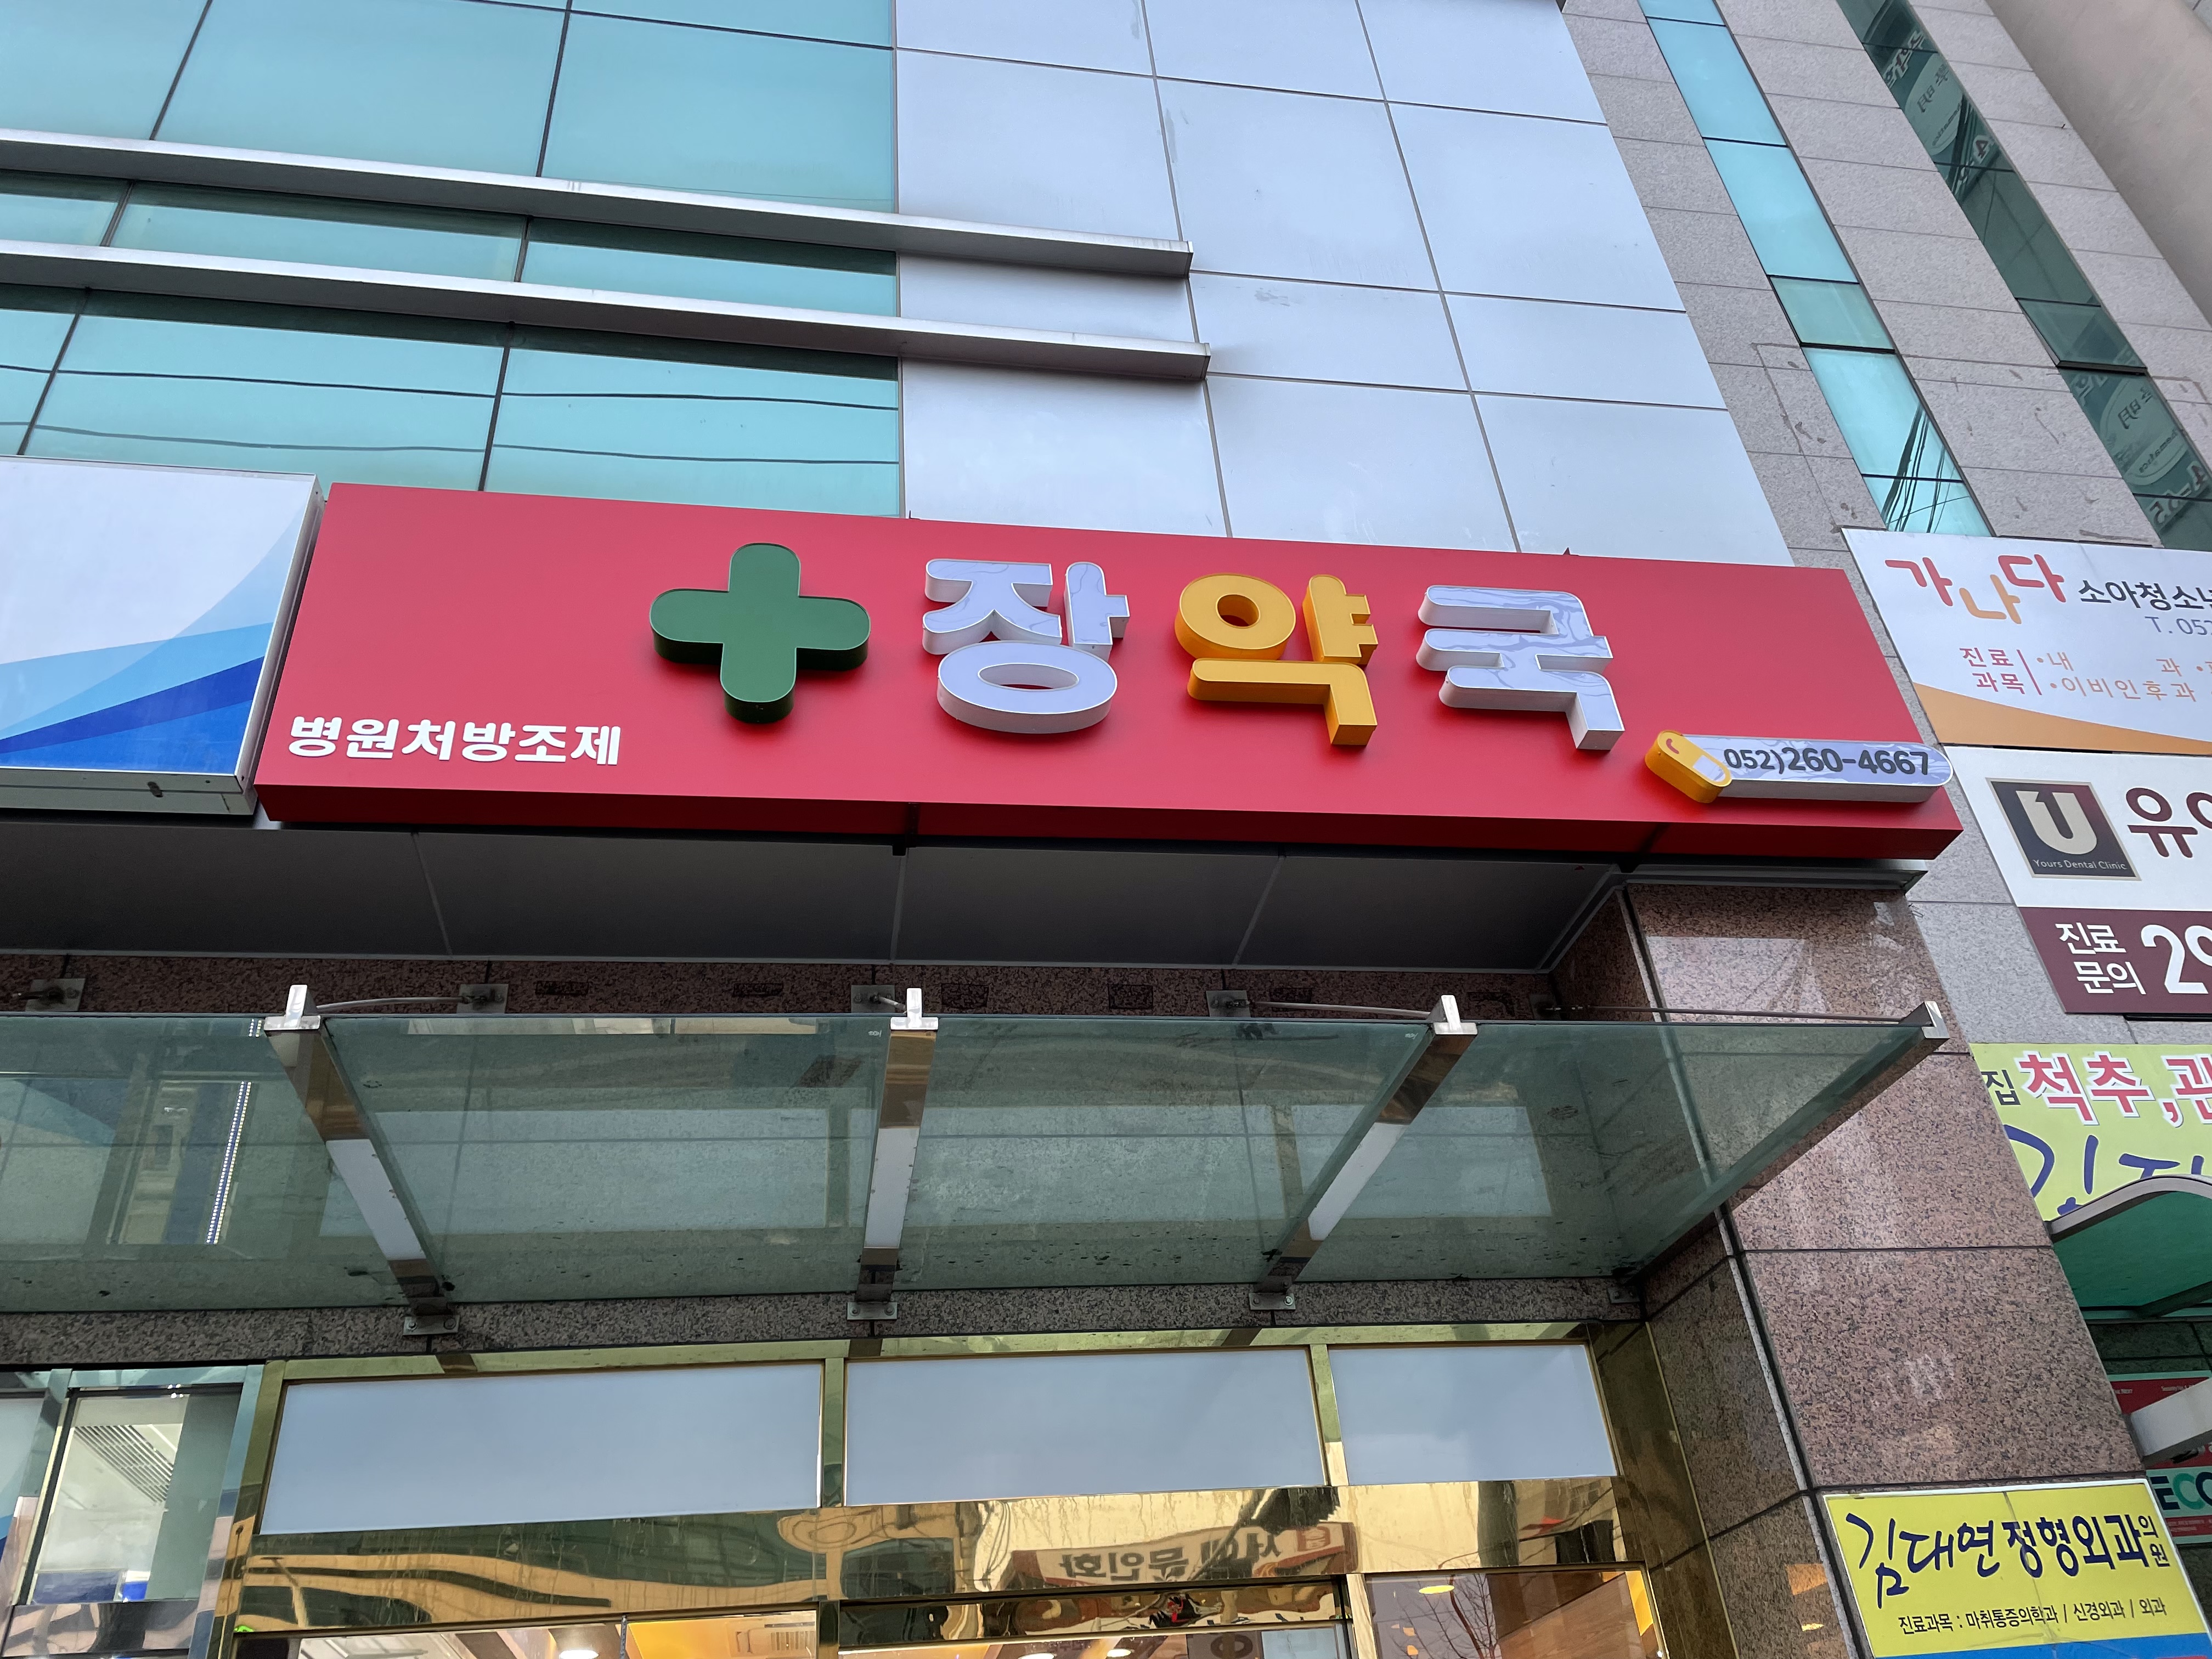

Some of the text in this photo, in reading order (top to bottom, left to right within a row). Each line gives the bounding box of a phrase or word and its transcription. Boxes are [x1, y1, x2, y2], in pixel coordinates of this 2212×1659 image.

[1885, 554, 2065, 624] 가나다
[922, 558, 1625, 751] 장약국
[1960, 647, 2014, 667] 진료
[1972, 672, 2025, 695] 과목
[289, 716, 621, 766] 병원처방조제
[1723, 747, 1929, 776] 052)260-4667
[2033, 859, 2128, 870] Yours Dental Clinic
[2056, 922, 2126, 955] 진료
[2074, 961, 2146, 995] 문의
[1899, 1614, 1953, 1635] 진료과목
[1966, 1605, 2058, 1629] 마취통증의학과
[2073, 1600, 2124, 1621] 신경외과
[2139, 1597, 2167, 1616] 외과
